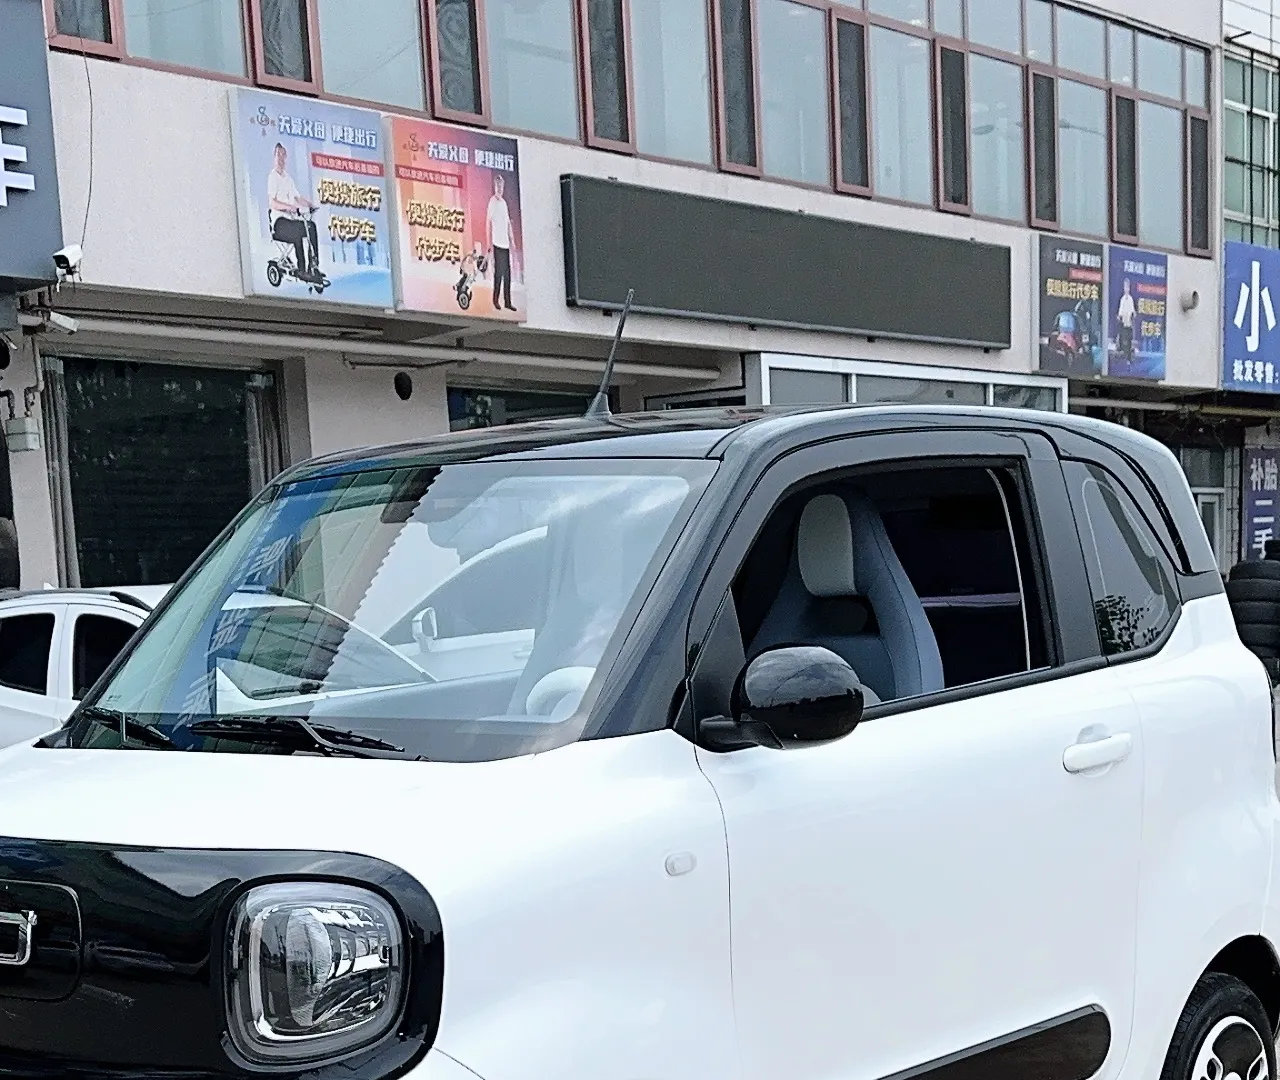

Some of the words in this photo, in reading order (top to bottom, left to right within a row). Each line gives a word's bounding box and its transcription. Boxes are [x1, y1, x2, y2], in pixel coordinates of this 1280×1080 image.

[318, 180, 381, 211] 便携旅行
[328, 215, 376, 244] 代步车
[415, 237, 460, 264] 代步车
[1250, 458, 1278, 491] 补胎
